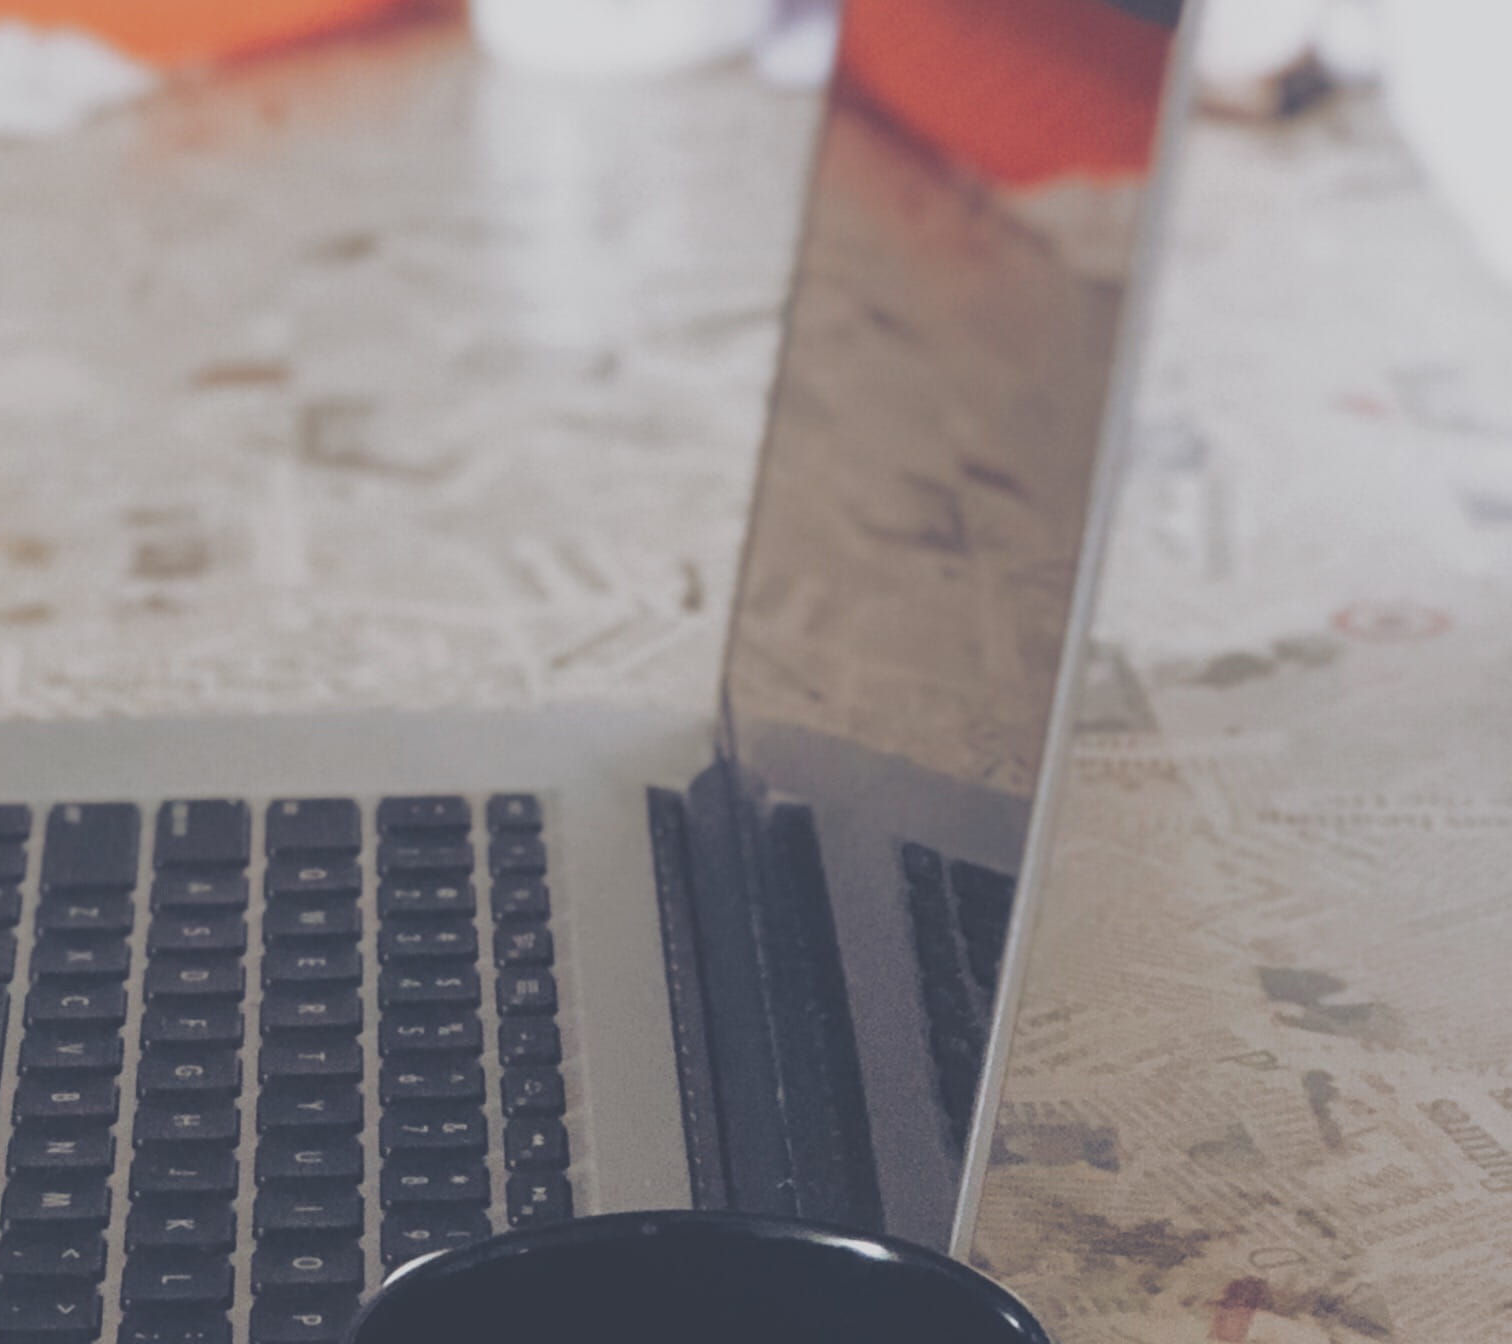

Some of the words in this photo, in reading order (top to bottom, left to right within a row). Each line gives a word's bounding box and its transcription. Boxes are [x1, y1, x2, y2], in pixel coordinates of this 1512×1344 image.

[181, 925, 212, 937] S
[297, 957, 327, 968] E
[179, 969, 210, 982] D
[60, 994, 90, 1008] C
[297, 1003, 327, 1014] R
[178, 1017, 208, 1029] F
[56, 1042, 85, 1055] V
[298, 1051, 326, 1062] T
[174, 1063, 204, 1077] G
[50, 1090, 81, 1103] B
[297, 1100, 325, 1112] Y
[172, 1112, 202, 1127] H
[45, 1140, 76, 1155] N
[294, 1151, 324, 1164] U
[40, 1191, 73, 1208] M
[165, 1218, 195, 1232] K
[402, 1229, 430, 1240] 9
[292, 1256, 324, 1270] O
[161, 1274, 192, 1285] L
[292, 1313, 323, 1327] P
